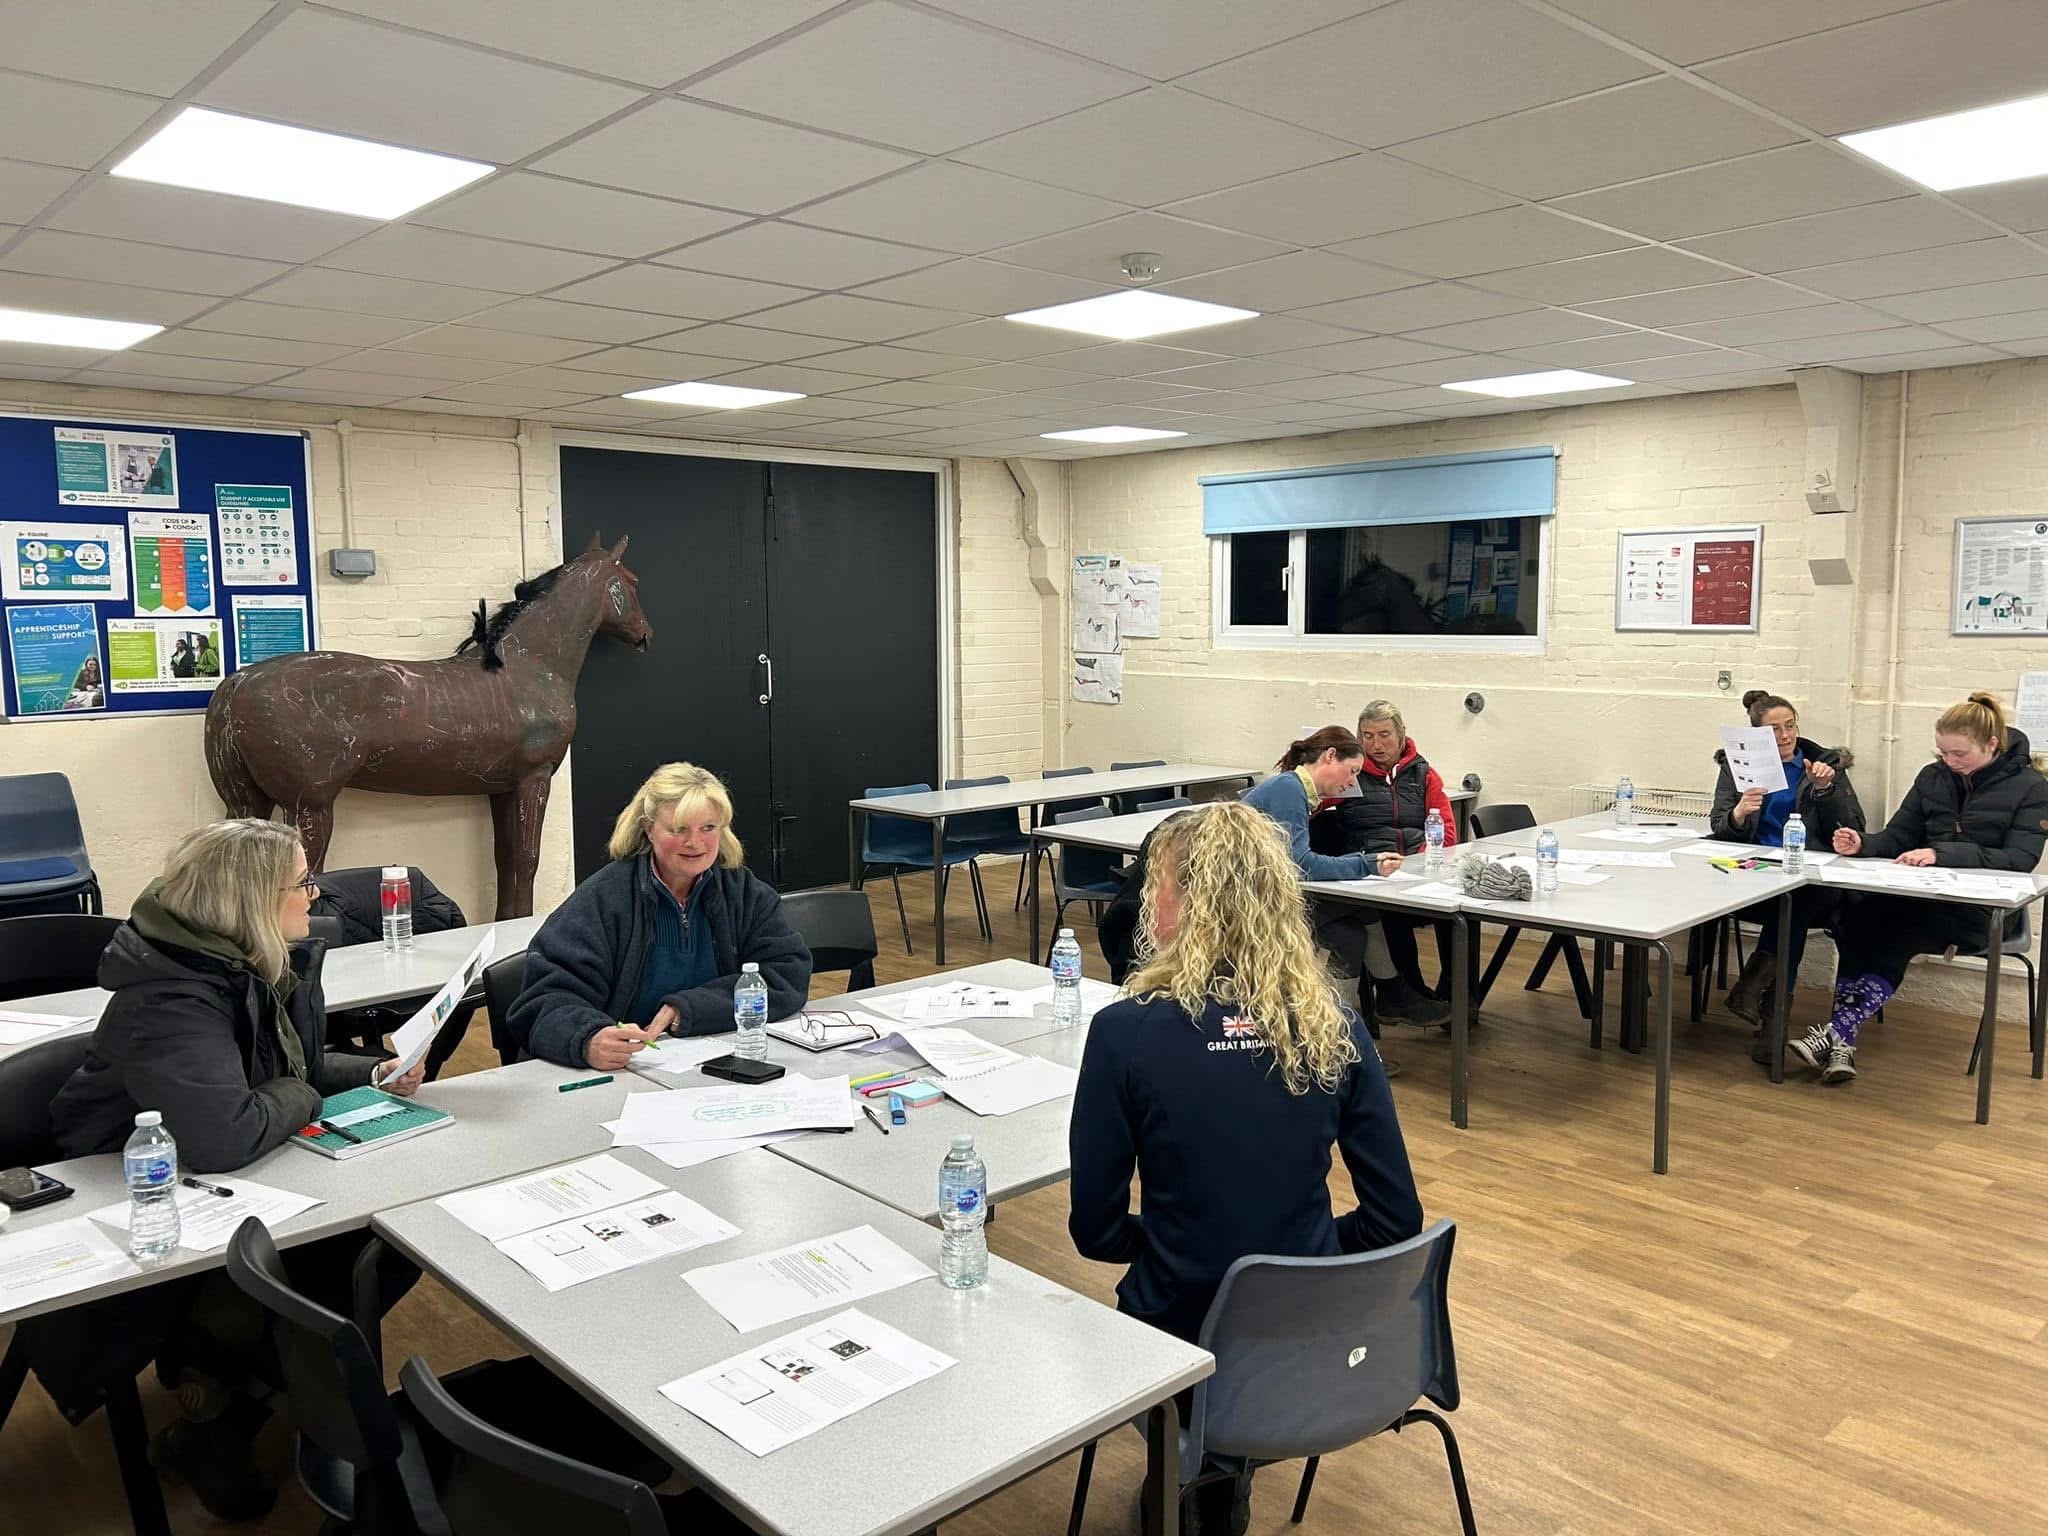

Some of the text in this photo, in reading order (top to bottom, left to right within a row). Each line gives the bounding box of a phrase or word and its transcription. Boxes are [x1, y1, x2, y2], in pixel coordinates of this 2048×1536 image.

[15, 623, 81, 634] APPRENTICESHIP
[51, 631, 86, 640] SUPPORT
[1207, 1041, 1239, 1051] GREAT
